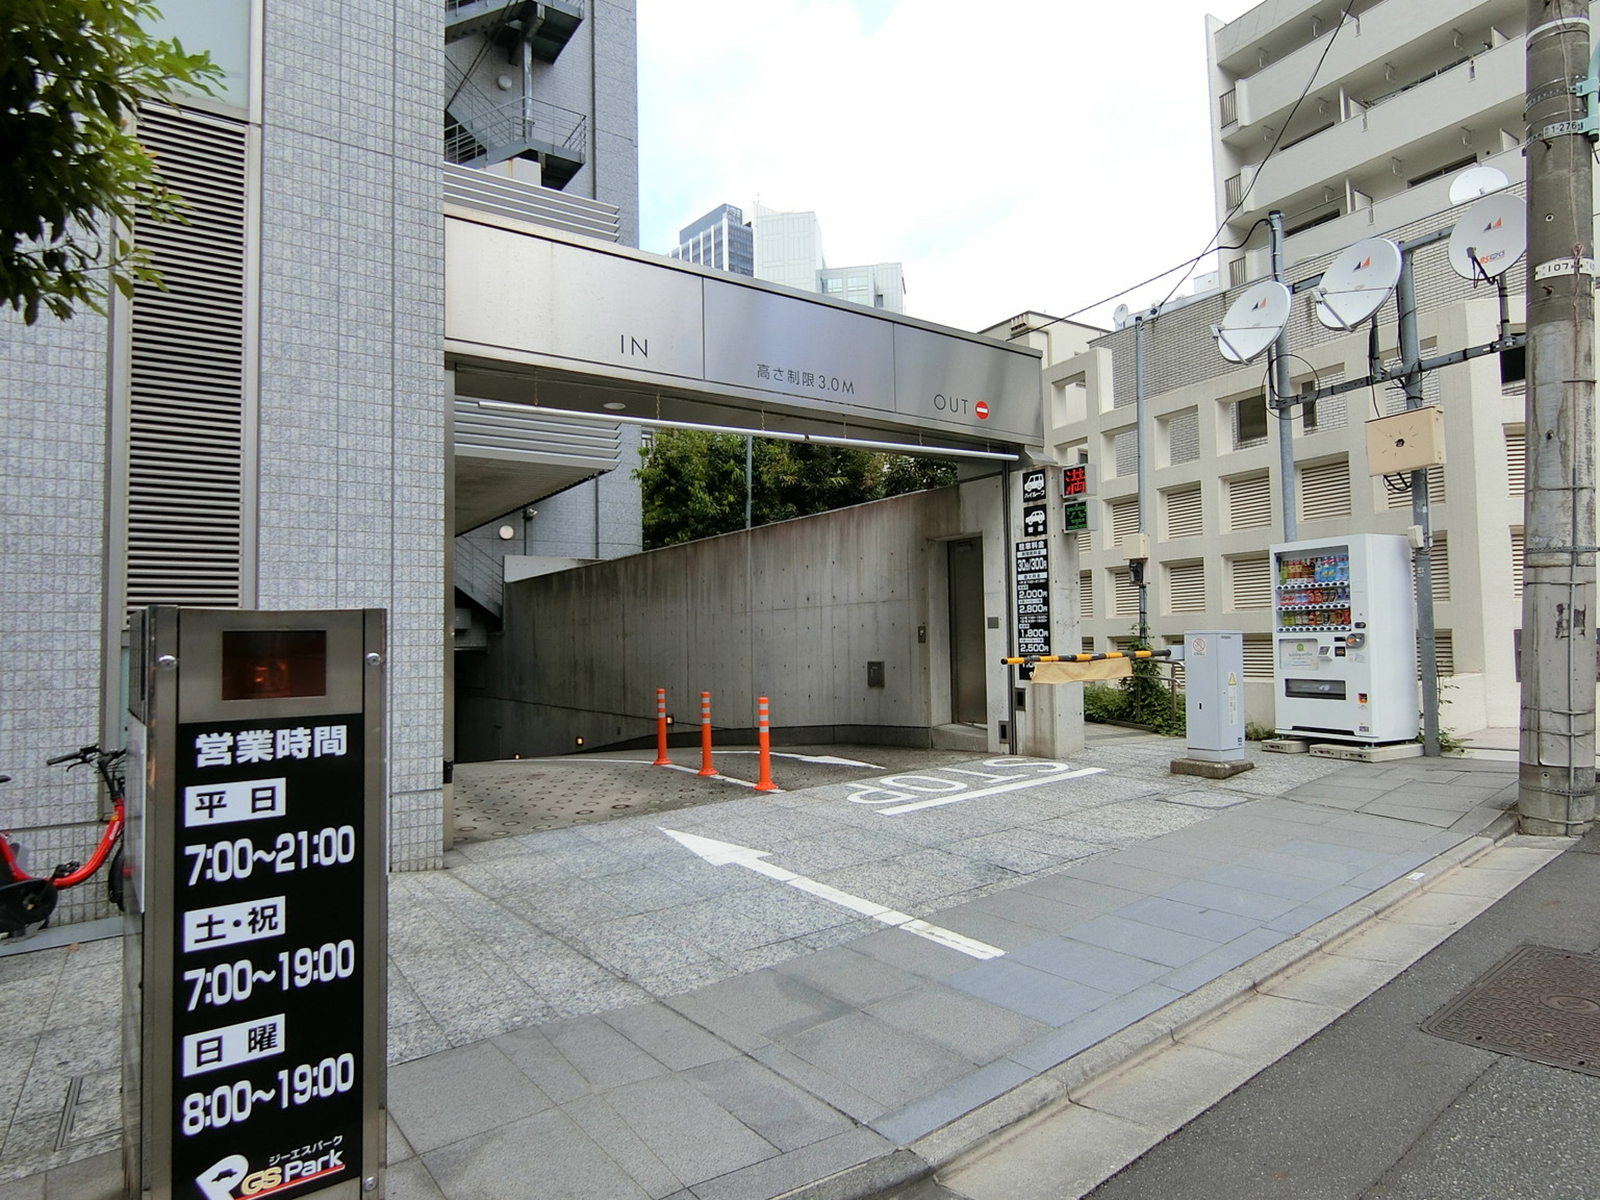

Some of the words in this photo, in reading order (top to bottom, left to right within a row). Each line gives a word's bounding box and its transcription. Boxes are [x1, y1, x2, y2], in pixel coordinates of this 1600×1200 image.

[1548, 262, 1569, 272] 107
[620, 334, 648, 358] IN
[756, 363, 855, 396] 高さ制限3.0M
[933, 394, 969, 415] OUT
[1024, 489, 1045, 499] ハイルーフ
[1065, 468, 1086, 496] 満
[195, 725, 348, 769] 営業時間
[195, 784, 278, 819] 平日
[195, 1023, 279, 1067] 日曜
[269, 1135, 343, 1166] ジーエスパーク
